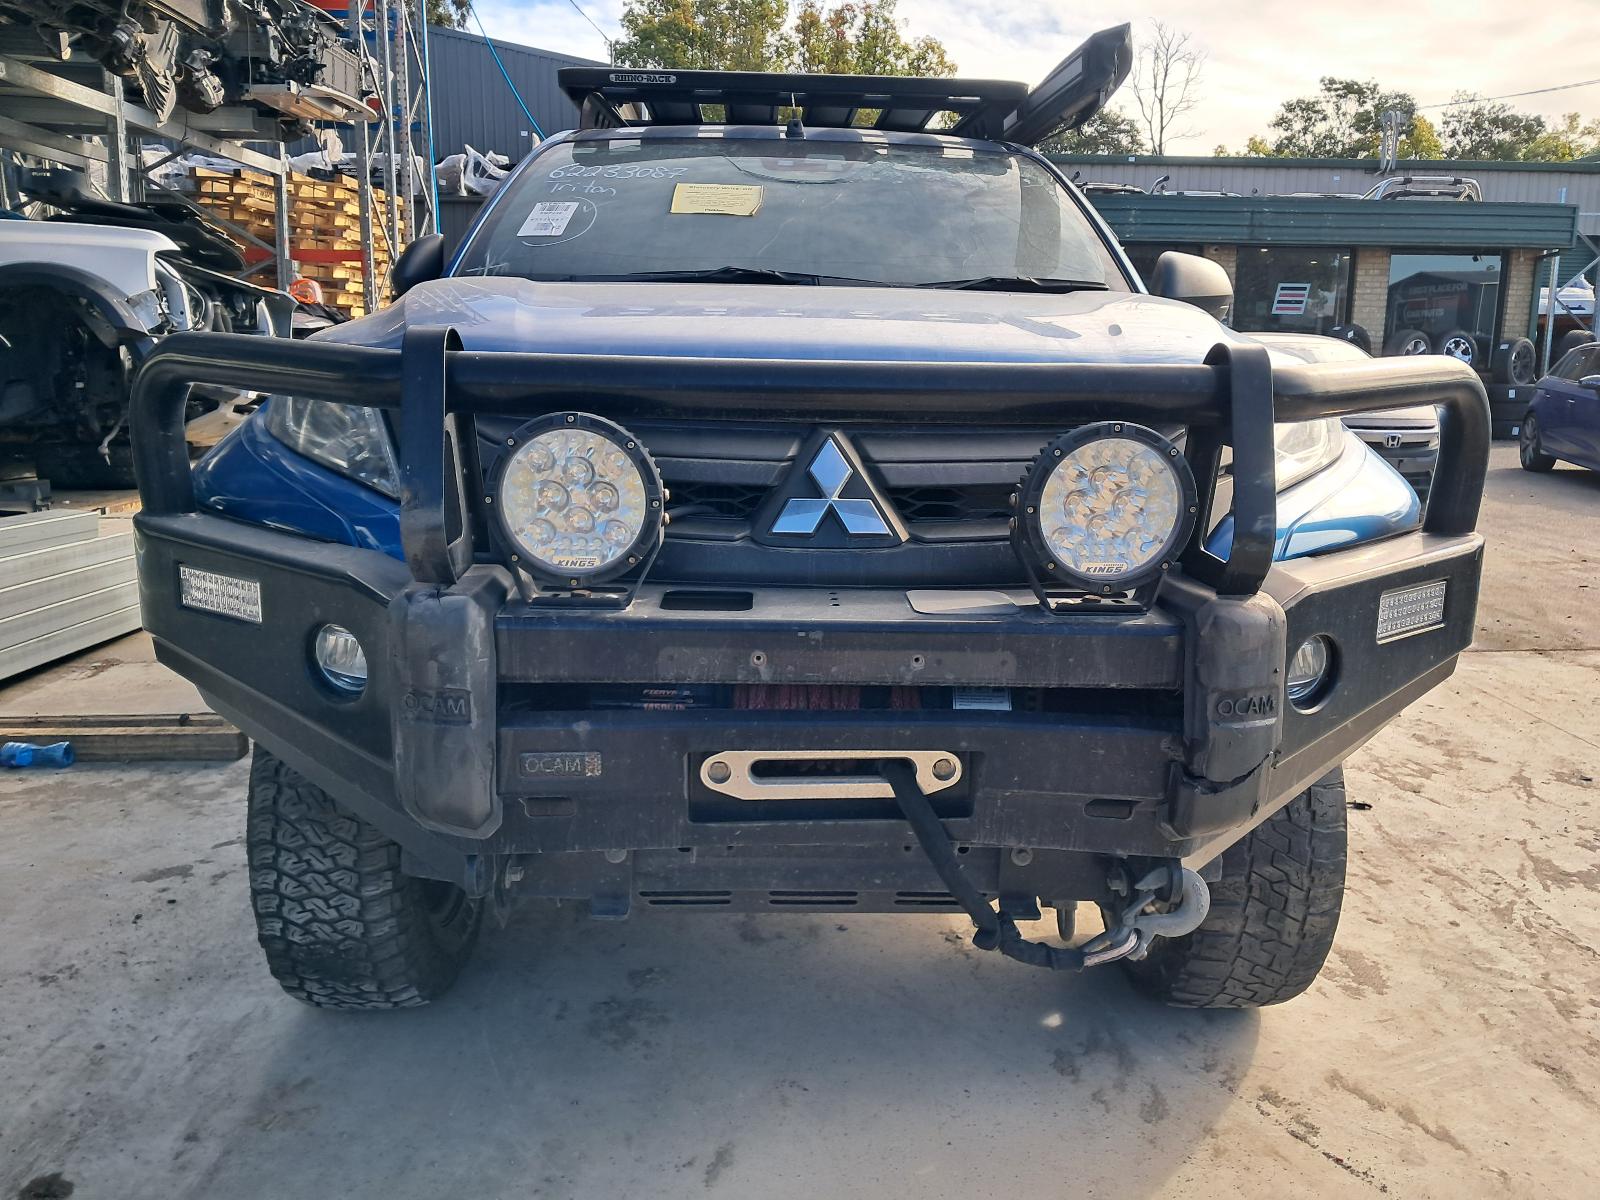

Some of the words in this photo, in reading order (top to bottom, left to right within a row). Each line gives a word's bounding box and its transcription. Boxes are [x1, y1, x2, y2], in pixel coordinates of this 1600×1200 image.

[614, 74, 672, 83] RHINO-RACK
[557, 559, 597, 568] KINGS
[1085, 566, 1124, 575] KINGS
[405, 693, 467, 715] OCAM
[1216, 695, 1275, 716] OCAM
[525, 757, 582, 773] OCAM
